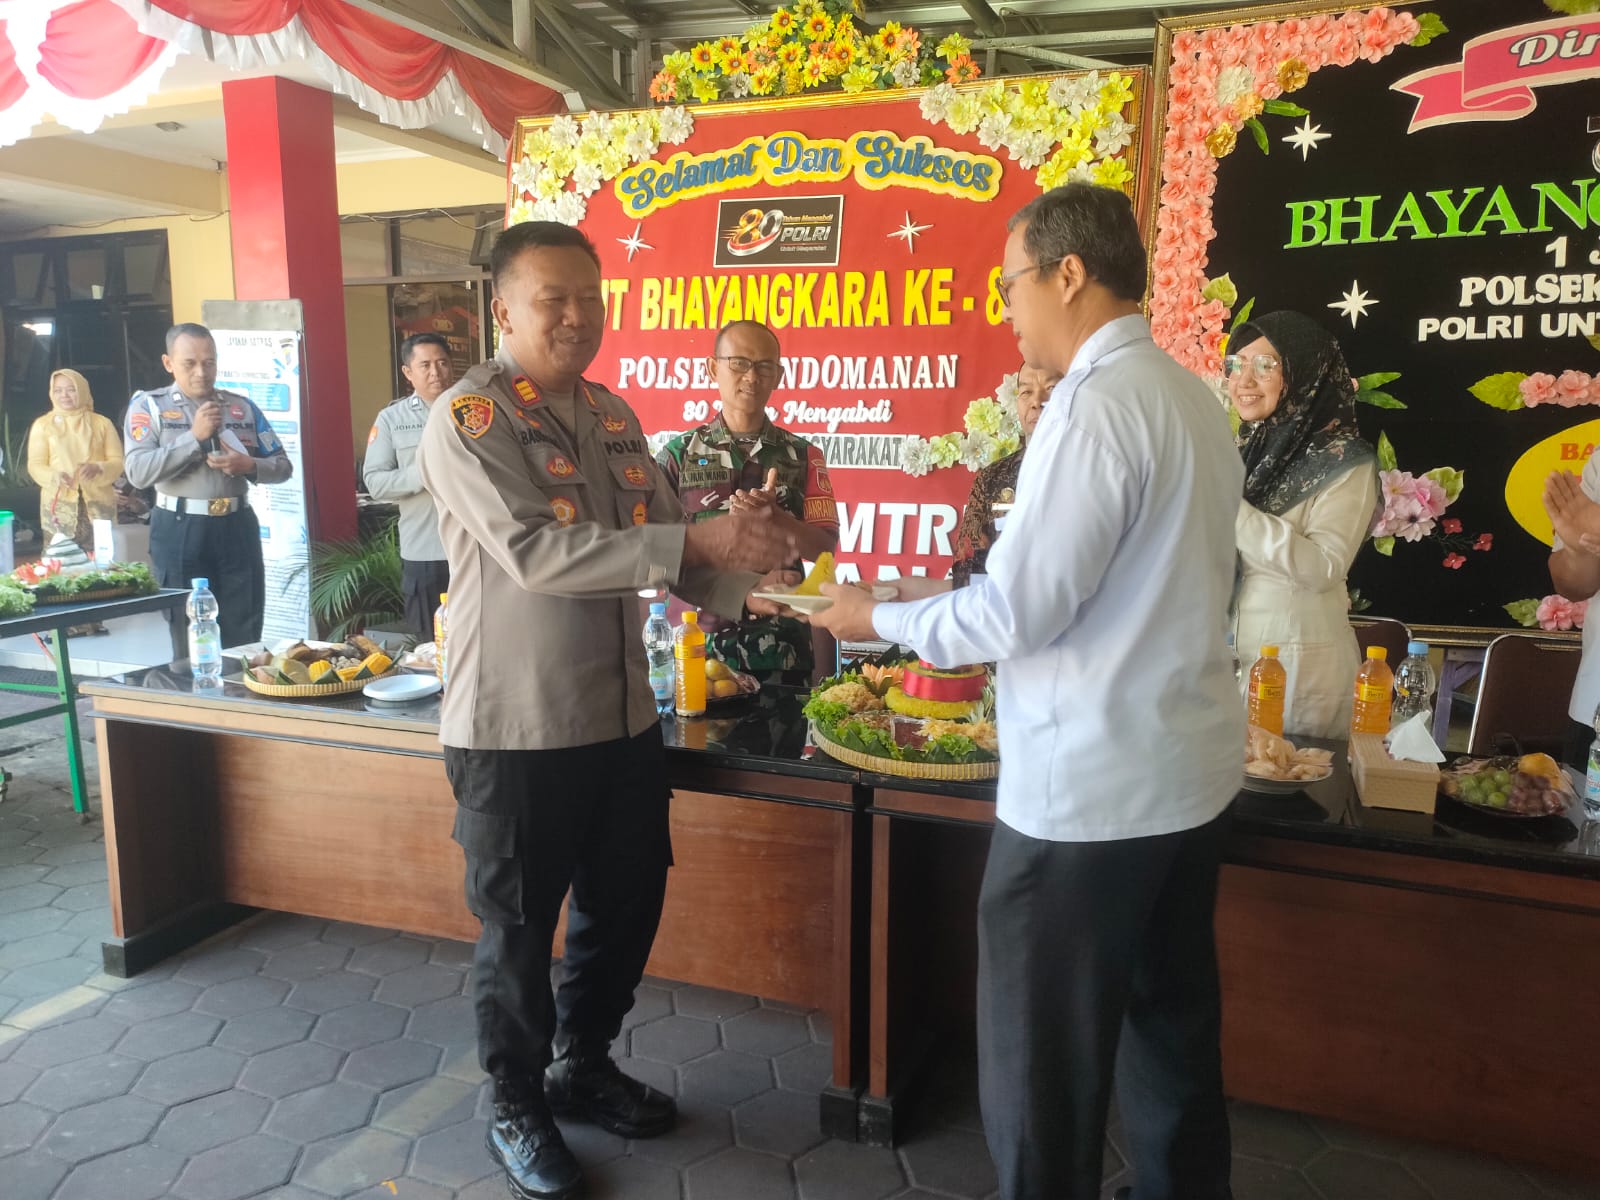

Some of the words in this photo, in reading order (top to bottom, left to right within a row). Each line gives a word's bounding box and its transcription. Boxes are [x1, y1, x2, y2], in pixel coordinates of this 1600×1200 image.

[621, 143, 761, 210] Selamat
[767, 136, 845, 176] Dan
[856, 135, 993, 193] Sukses
[780, 226, 832, 241] POLRI
[1545, 236, 1568, 268] 1
[640, 271, 889, 331] BHAYANGKARA
[903, 268, 953, 326] KE
[985, 266, 1003, 326] 8
[1418, 315, 1524, 342] POLRI
[618, 356, 719, 389] POLSE
[776, 354, 959, 390] NDOMANAN
[394, 423, 426, 431] JOHAN
[682, 400, 710, 422] 80
[782, 400, 893, 433] Mengabdi
[604, 440, 642, 456] POLRI
[1560, 443, 1595, 460] BA
